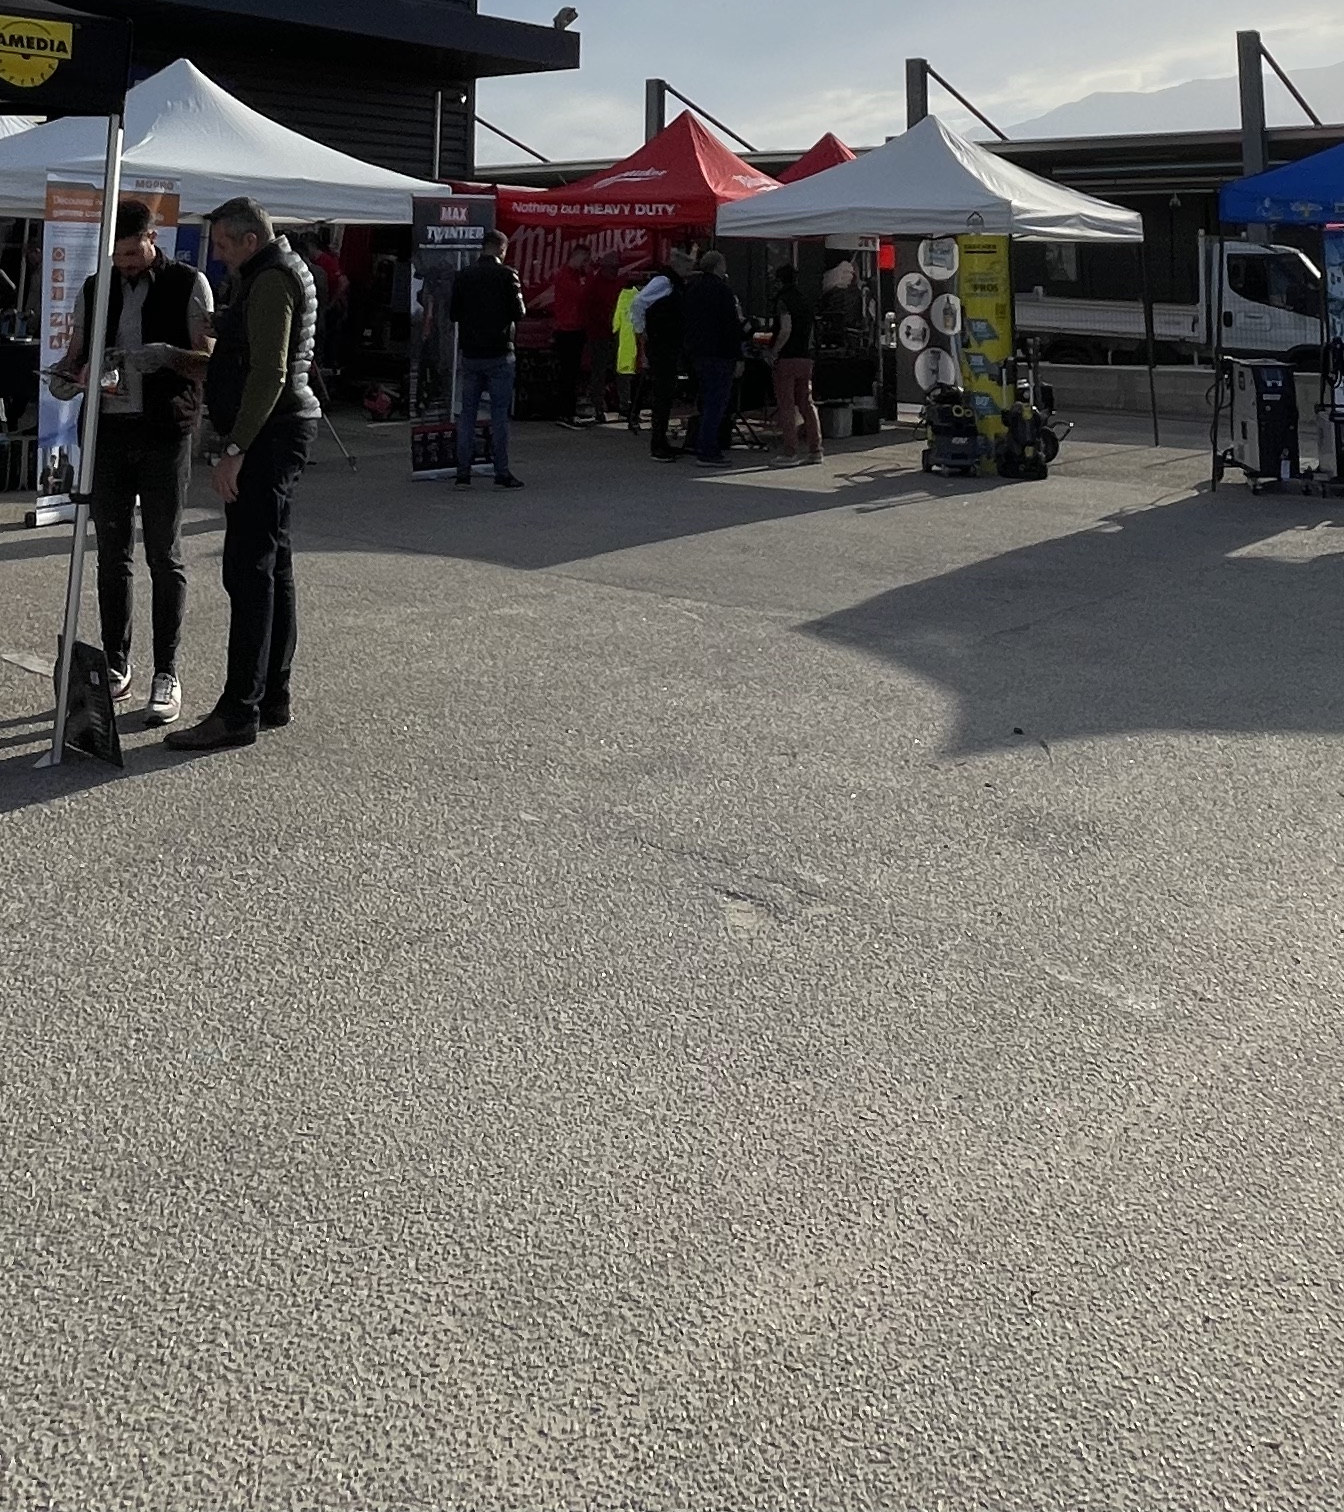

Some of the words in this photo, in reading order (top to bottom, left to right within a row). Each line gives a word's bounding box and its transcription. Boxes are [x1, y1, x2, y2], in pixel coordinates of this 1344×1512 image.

[440, 206, 467, 221] MAX
[512, 202, 558, 217] Nothing
[561, 203, 581, 216] but
[584, 203, 630, 216] HEAVY
